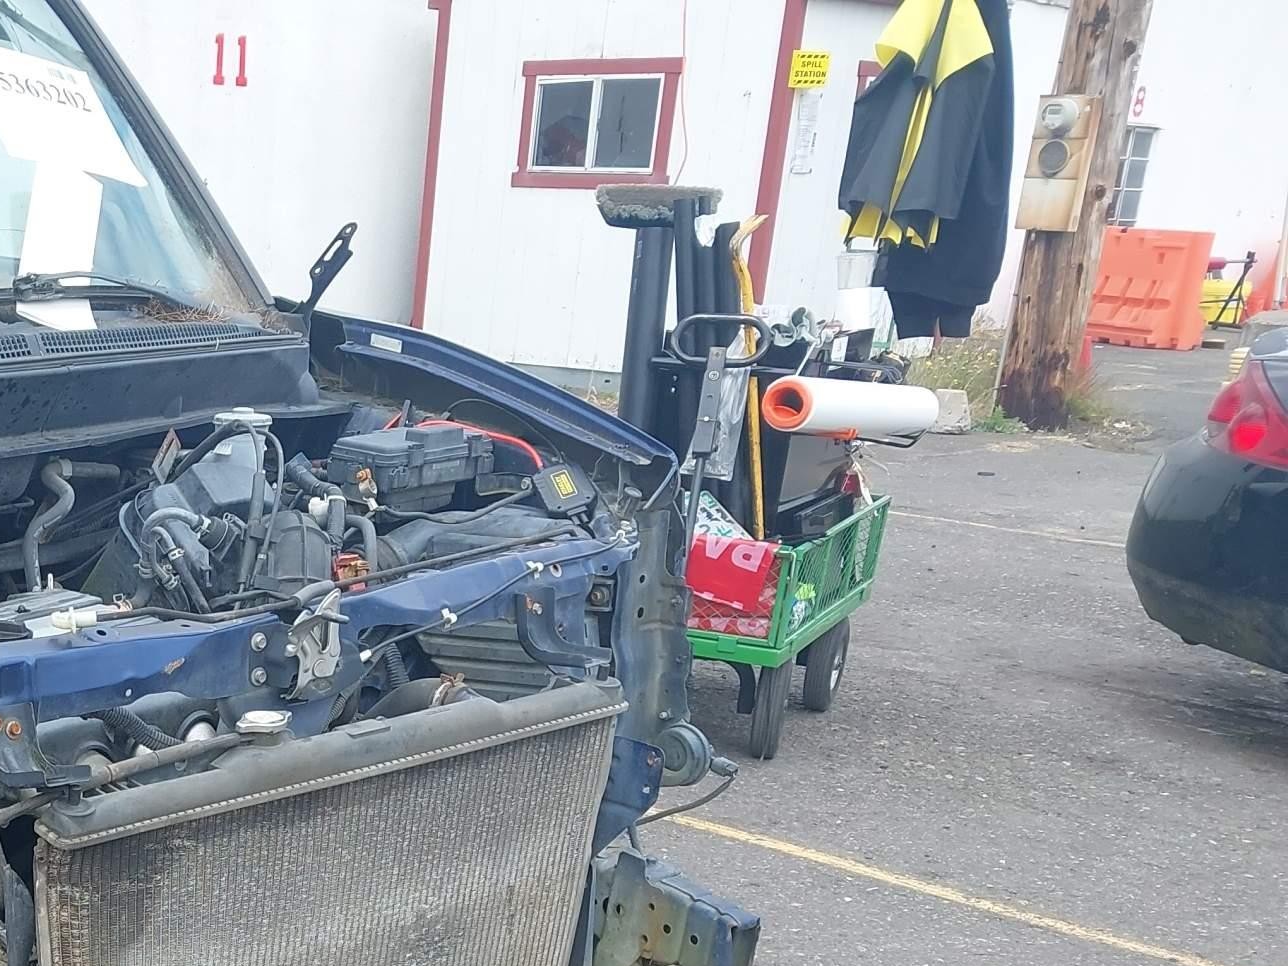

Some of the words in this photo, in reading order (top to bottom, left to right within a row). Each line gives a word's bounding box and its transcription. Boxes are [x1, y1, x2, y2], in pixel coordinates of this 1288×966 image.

[212, 33, 248, 87] 11
[800, 60, 824, 68] SPILL
[794, 69, 827, 78] STATION
[1132, 86, 1147, 118] 8
